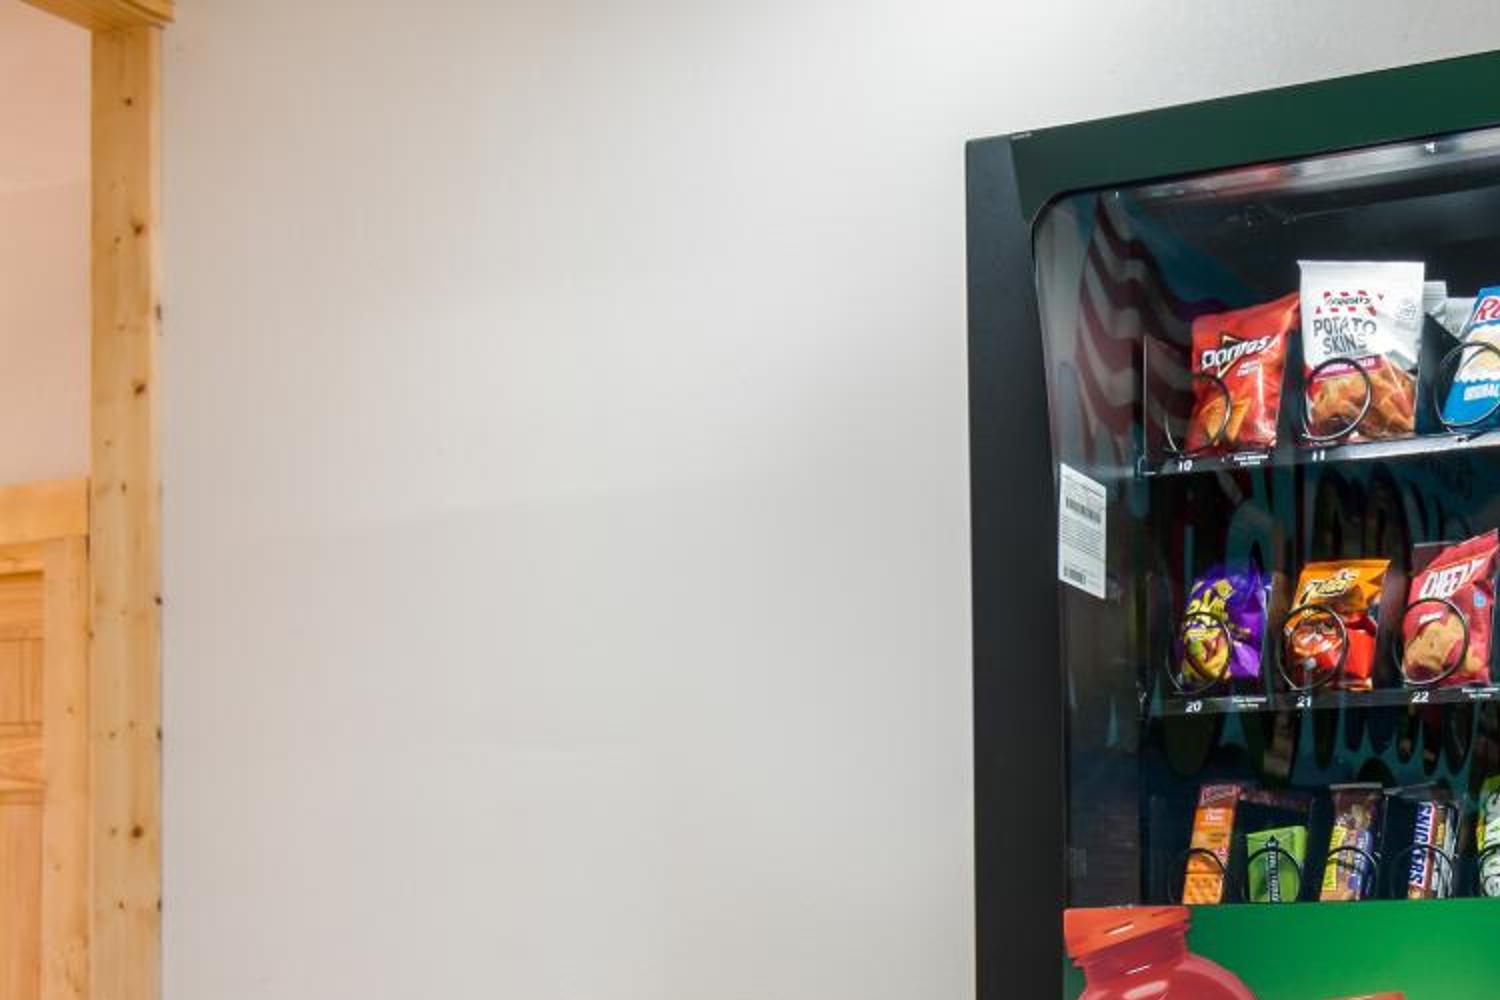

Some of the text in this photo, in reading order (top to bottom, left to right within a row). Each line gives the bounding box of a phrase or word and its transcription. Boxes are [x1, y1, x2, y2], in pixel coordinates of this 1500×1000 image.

[1313, 317, 1377, 337] POTATO
[1201, 336, 1271, 370] Doritos
[1323, 333, 1367, 355] SKINS
